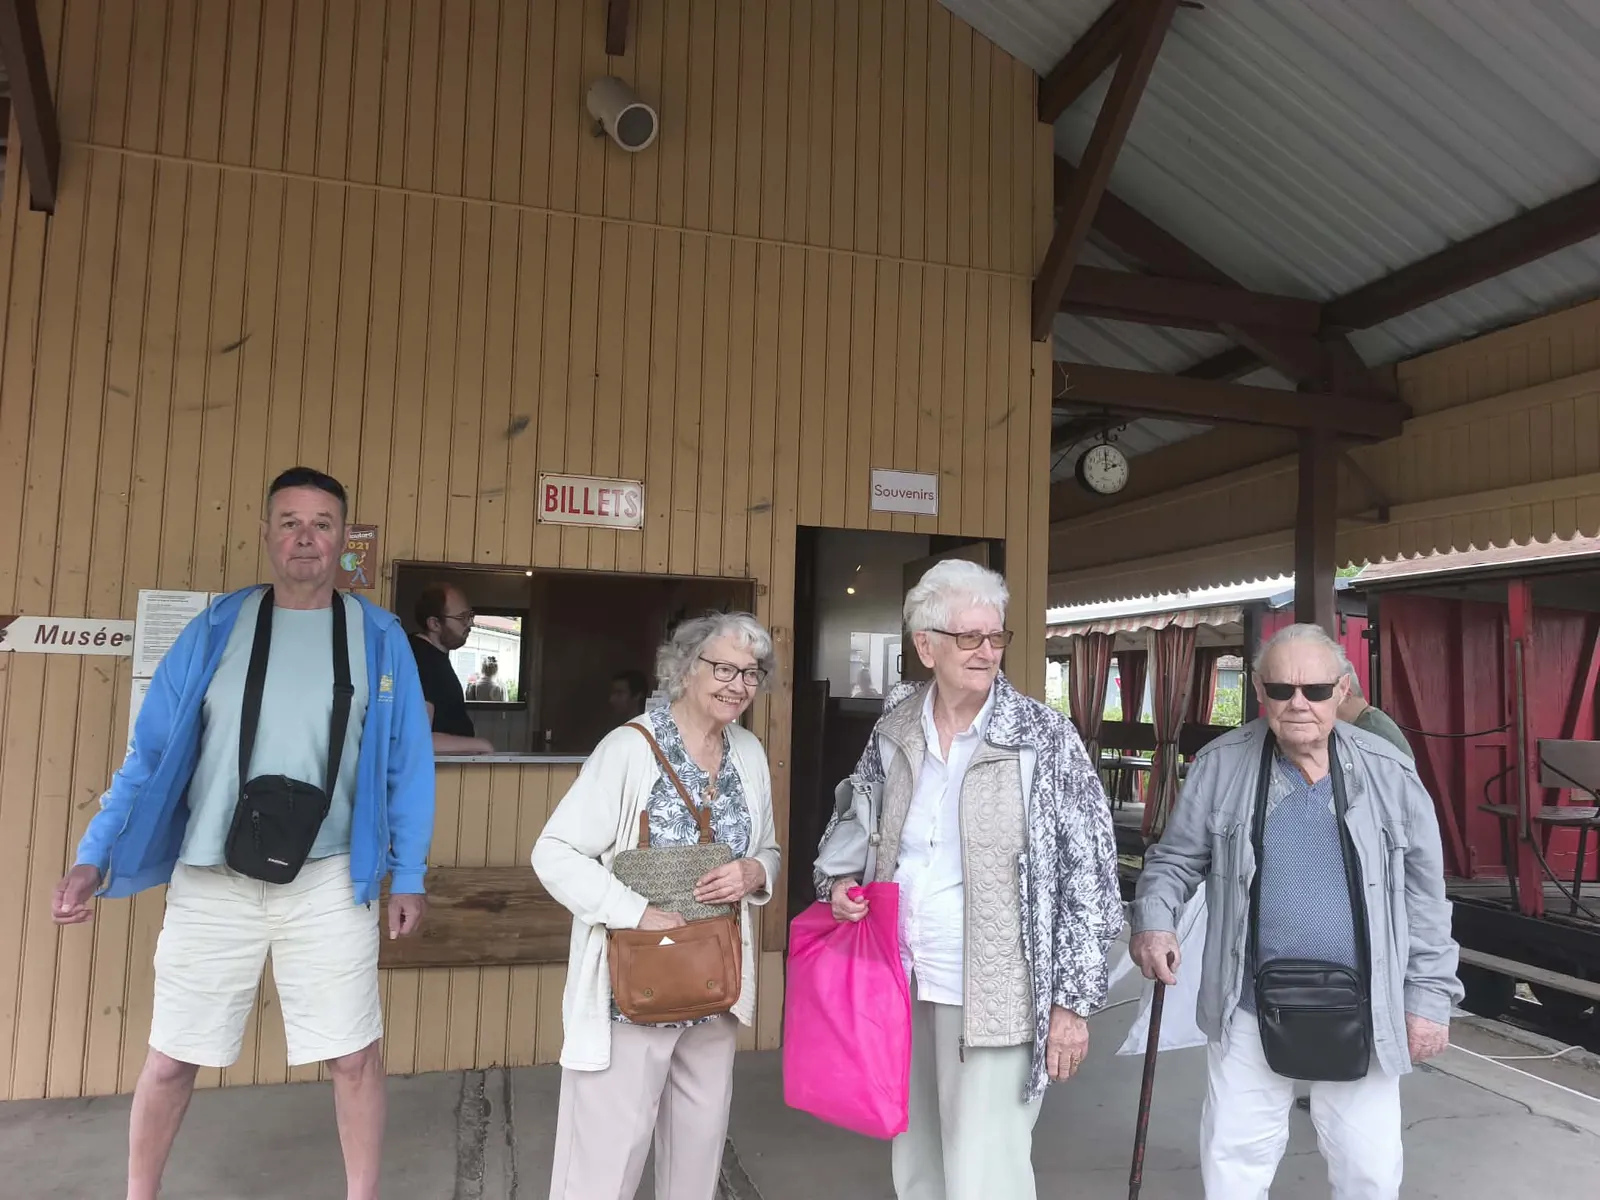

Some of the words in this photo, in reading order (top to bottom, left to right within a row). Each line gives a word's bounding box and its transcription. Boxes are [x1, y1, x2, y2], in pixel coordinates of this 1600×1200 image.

[545, 484, 638, 518] BILLETS
[874, 484, 934, 500] Souvenirs
[348, 541, 369, 550] 021
[34, 624, 124, 647] Musée
